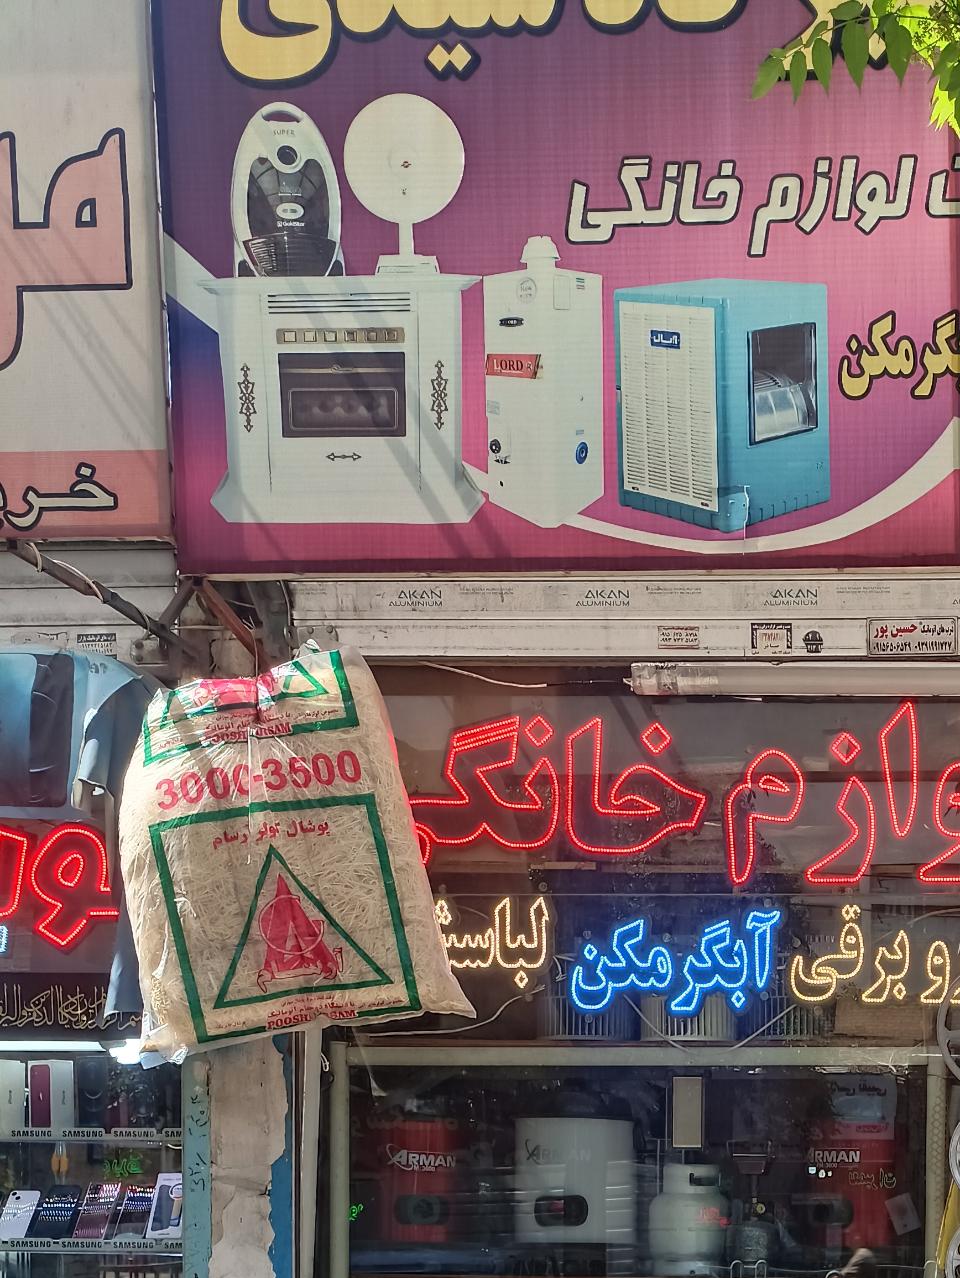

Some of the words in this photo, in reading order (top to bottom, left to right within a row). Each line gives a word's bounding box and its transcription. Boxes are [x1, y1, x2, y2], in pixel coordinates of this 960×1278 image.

[567, 153, 740, 246] خانگی
[745, 152, 920, 260] لوازم
[493, 358, 524, 372] LORD
[398, 589, 442, 600] AKAN
[584, 589, 630, 600] AKAN
[772, 588, 818, 599] AKAN
[576, 599, 630, 607] ALUMINIUM
[873, 624, 889, 640] پور
[890, 623, 918, 638] حسین
[286, 819, 332, 839] پوشال
[571, 908, 781, 1012] آبگرمکن
[11, 1130, 52, 1138] SAMSUNG
[62, 1130, 103, 1138] SAMSUNG
[113, 1130, 155, 1138] SAMSUNG
[386, 1146, 457, 1170] ARMAN
[10, 1240, 52, 1248] SAMSUNG
[113, 1241, 154, 1249] SAMSUNG
